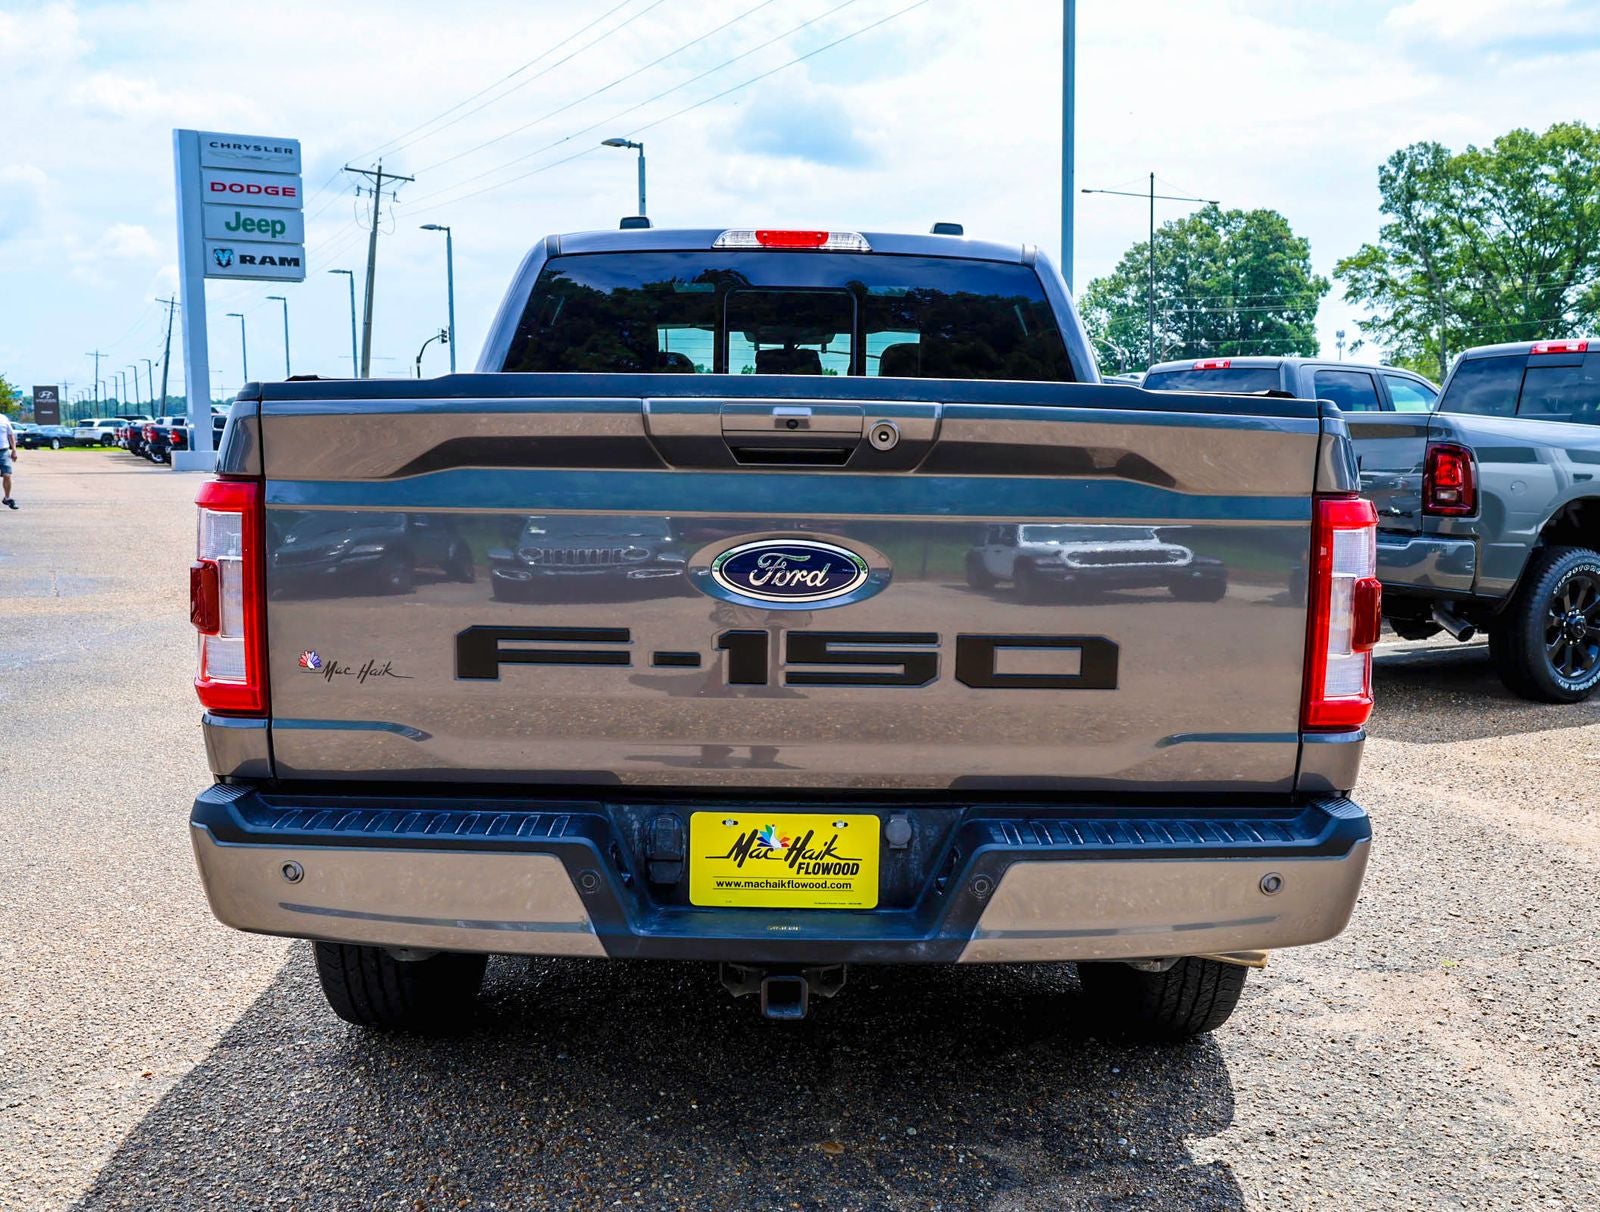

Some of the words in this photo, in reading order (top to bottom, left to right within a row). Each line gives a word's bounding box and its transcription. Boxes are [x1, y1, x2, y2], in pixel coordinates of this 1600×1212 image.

[209, 141, 294, 155] CHRYSLER
[210, 181, 297, 197] DODGE
[224, 211, 286, 238] Jeep
[239, 254, 300, 267] RAM
[748, 552, 832, 587] Ford
[454, 624, 1120, 690] F-150
[301, 660, 356, 682] Mac
[357, 659, 415, 684] Haik
[705, 828, 782, 868] Mac
[783, 829, 863, 869] Haik
[796, 862, 860, 876] FLOWOOD
[716, 879, 852, 890] www.machaikflowood.com
